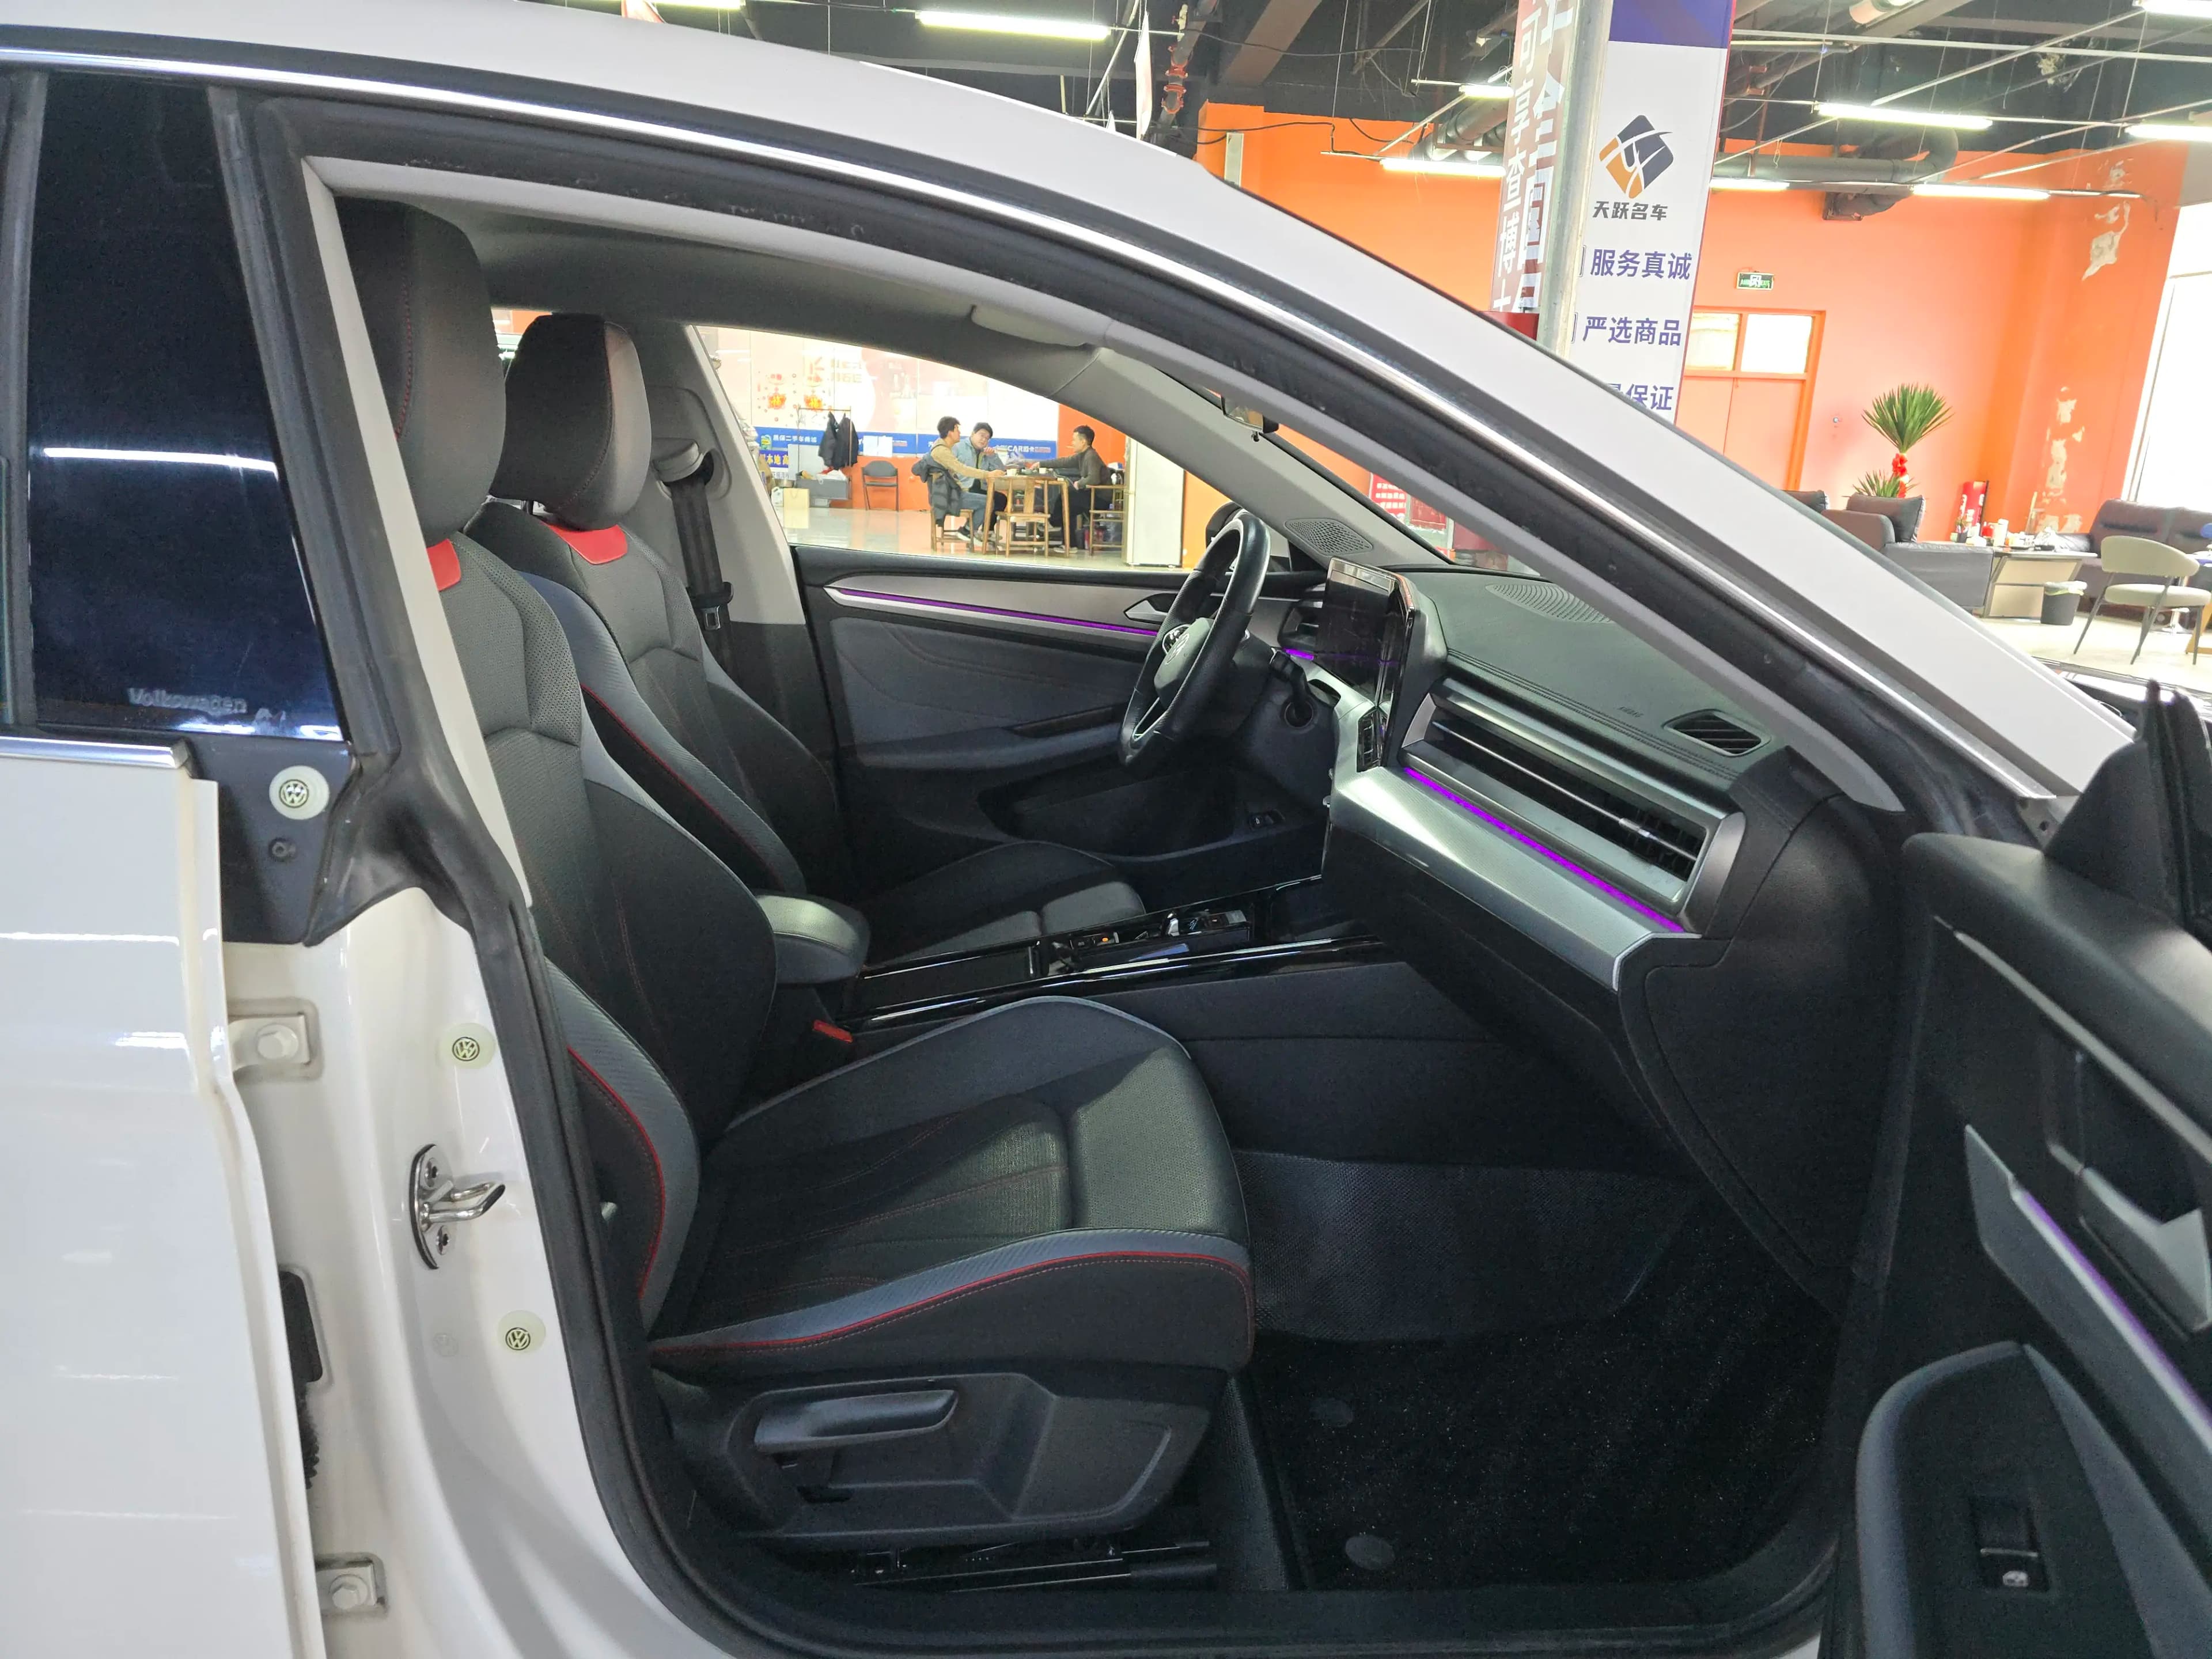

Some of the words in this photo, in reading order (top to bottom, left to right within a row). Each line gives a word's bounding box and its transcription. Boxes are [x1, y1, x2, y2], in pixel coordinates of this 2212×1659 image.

[1493, 0, 1542, 312] 可享查博士
[1592, 200, 1668, 221] 天跃名车
[1590, 249, 1692, 280] 服务真诚
[1582, 316, 1682, 346] 严选商品
[1609, 383, 1675, 411] 保证
